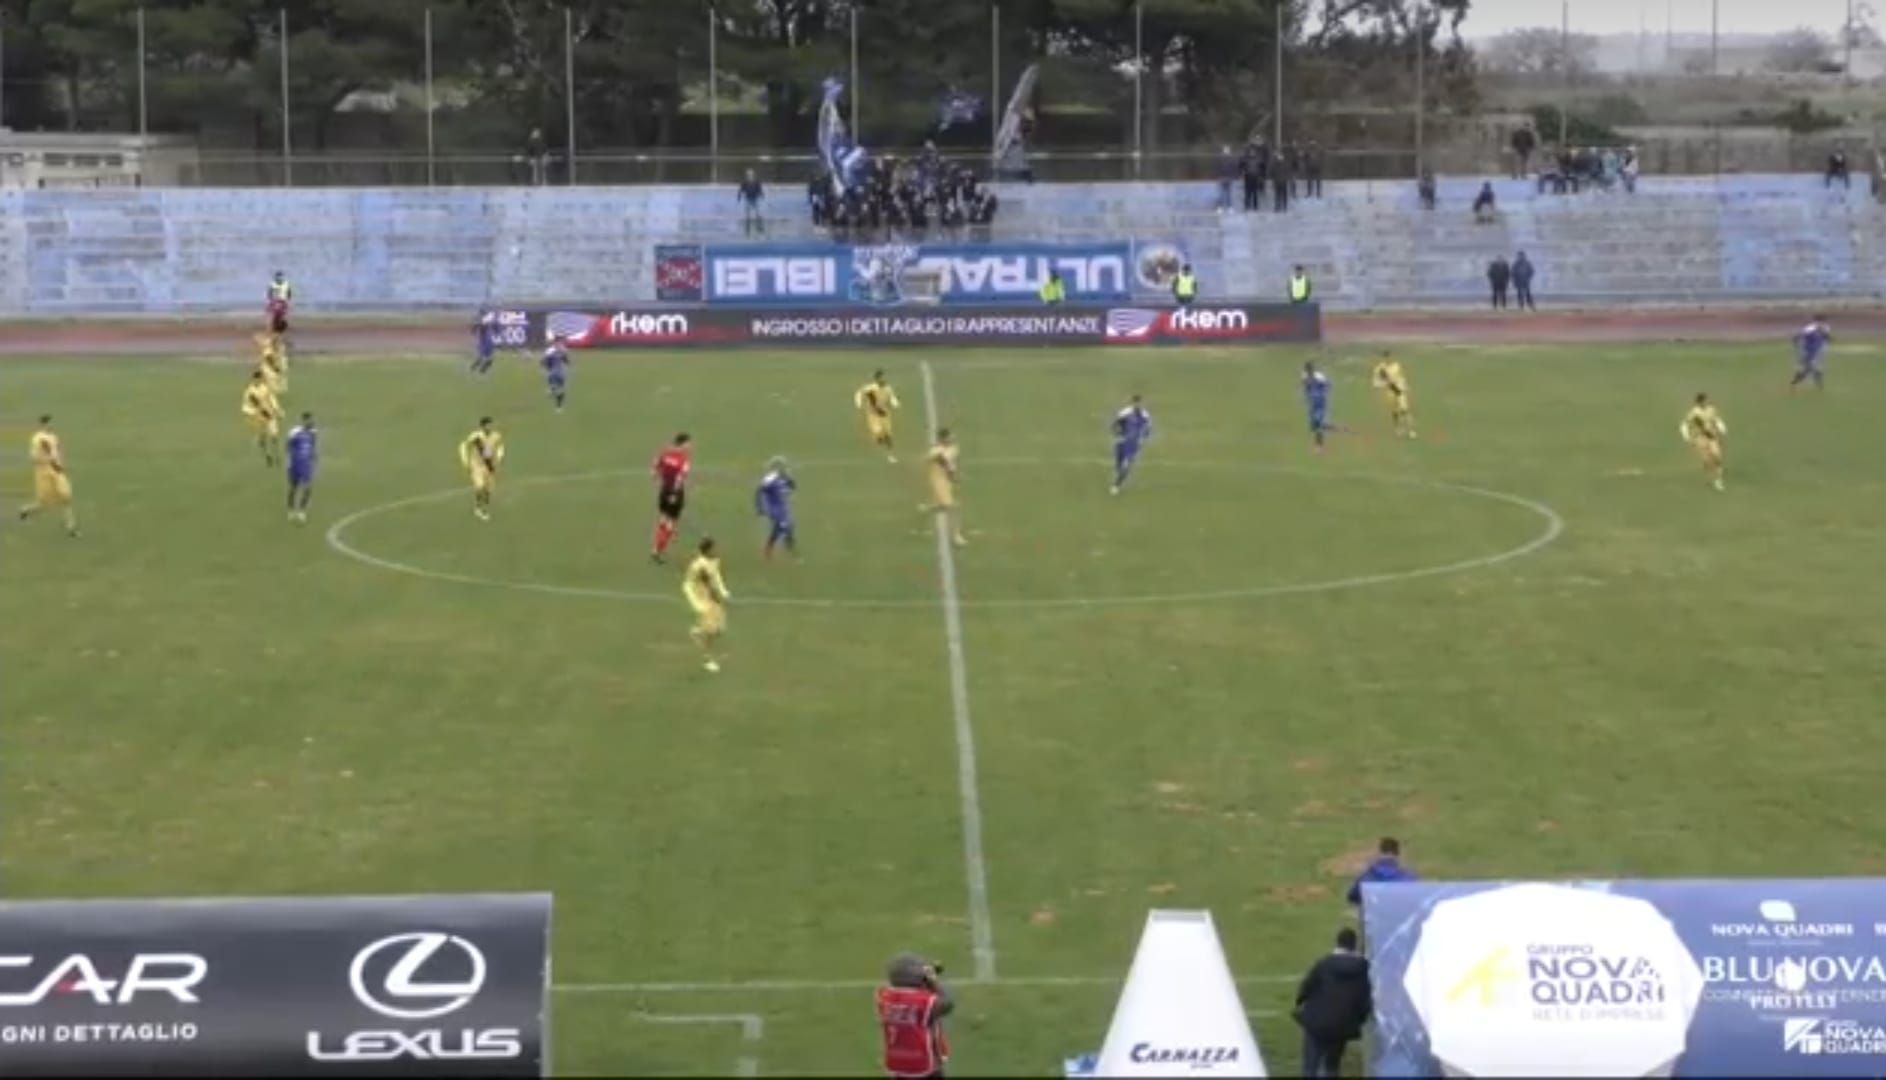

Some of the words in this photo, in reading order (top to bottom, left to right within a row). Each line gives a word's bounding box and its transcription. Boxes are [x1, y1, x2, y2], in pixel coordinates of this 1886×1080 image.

[714, 257, 836, 295] IBLEI
[610, 311, 688, 334] rkem
[752, 319, 842, 336] INGROSSO
[851, 318, 946, 335] DETTAGLIO
[953, 317, 1100, 334] RAPPRESENTANZE
[1169, 307, 1247, 330] rkem
[1711, 923, 1770, 937] NOVA
[1774, 923, 1854, 938] QUADRI
[1528, 957, 1661, 979] NOVA
[1532, 980, 1665, 1004] QUADRI
[54, 1023, 198, 1042] DETTAGLIO
[1825, 1026, 1886, 1040] NOVA
[307, 1028, 522, 1061] LEXUS
